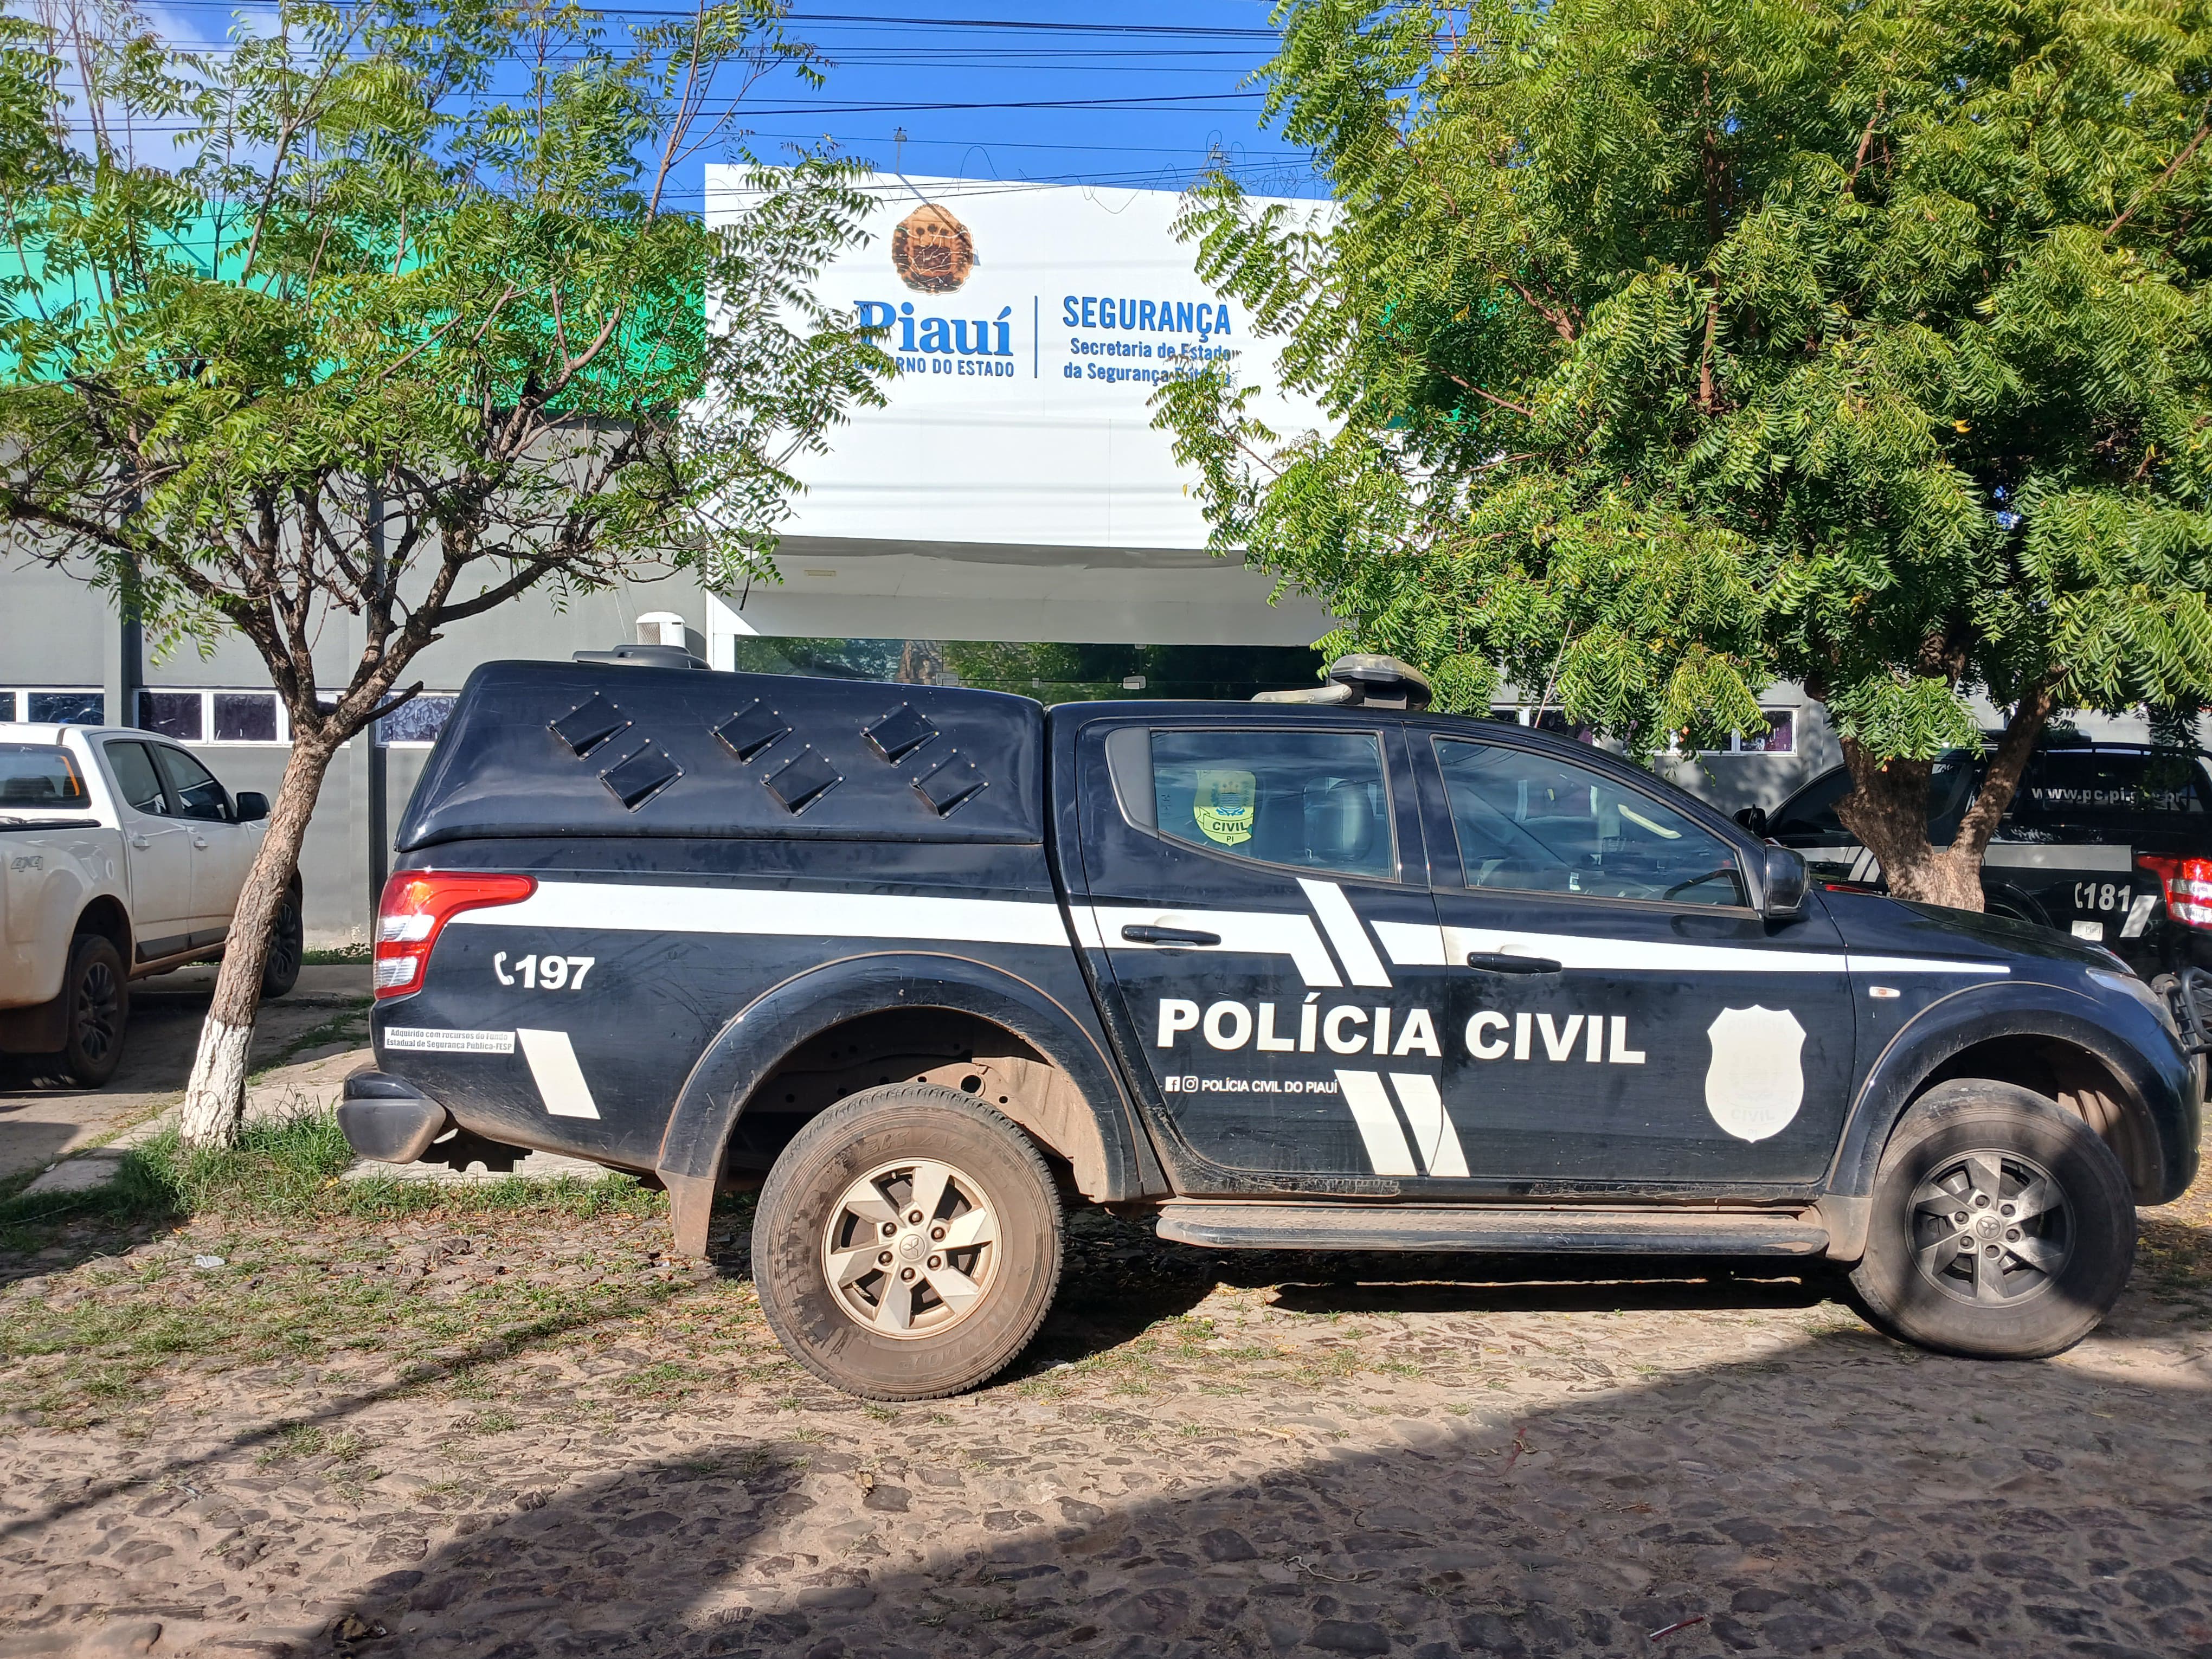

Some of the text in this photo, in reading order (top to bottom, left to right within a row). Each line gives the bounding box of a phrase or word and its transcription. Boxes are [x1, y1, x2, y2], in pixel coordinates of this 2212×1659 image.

[853, 300, 1014, 357] Piauí
[1063, 295, 1231, 343] SEGURANÇA
[1070, 337, 1231, 361] Secretaria de Estado
[933, 358, 952, 374] DO
[957, 360, 1014, 377] ESTADO
[1064, 362, 1082, 378] da
[1088, 363, 1169, 386] Segurança
[1212, 821, 1247, 832] CIVIL
[2084, 883, 2131, 911] 181
[515, 954, 595, 990] 197
[391, 1029, 424, 1038] Adquirido
[1157, 992, 1647, 1064] POLÍCIA CIVIL
[387, 1039, 415, 1047] Estadual
[417, 1039, 426, 1047] de
[427, 1040, 465, 1050] Segurança
[1201, 1077, 1338, 1094] POLÍCIA CIVIL DO PIAUÍ
